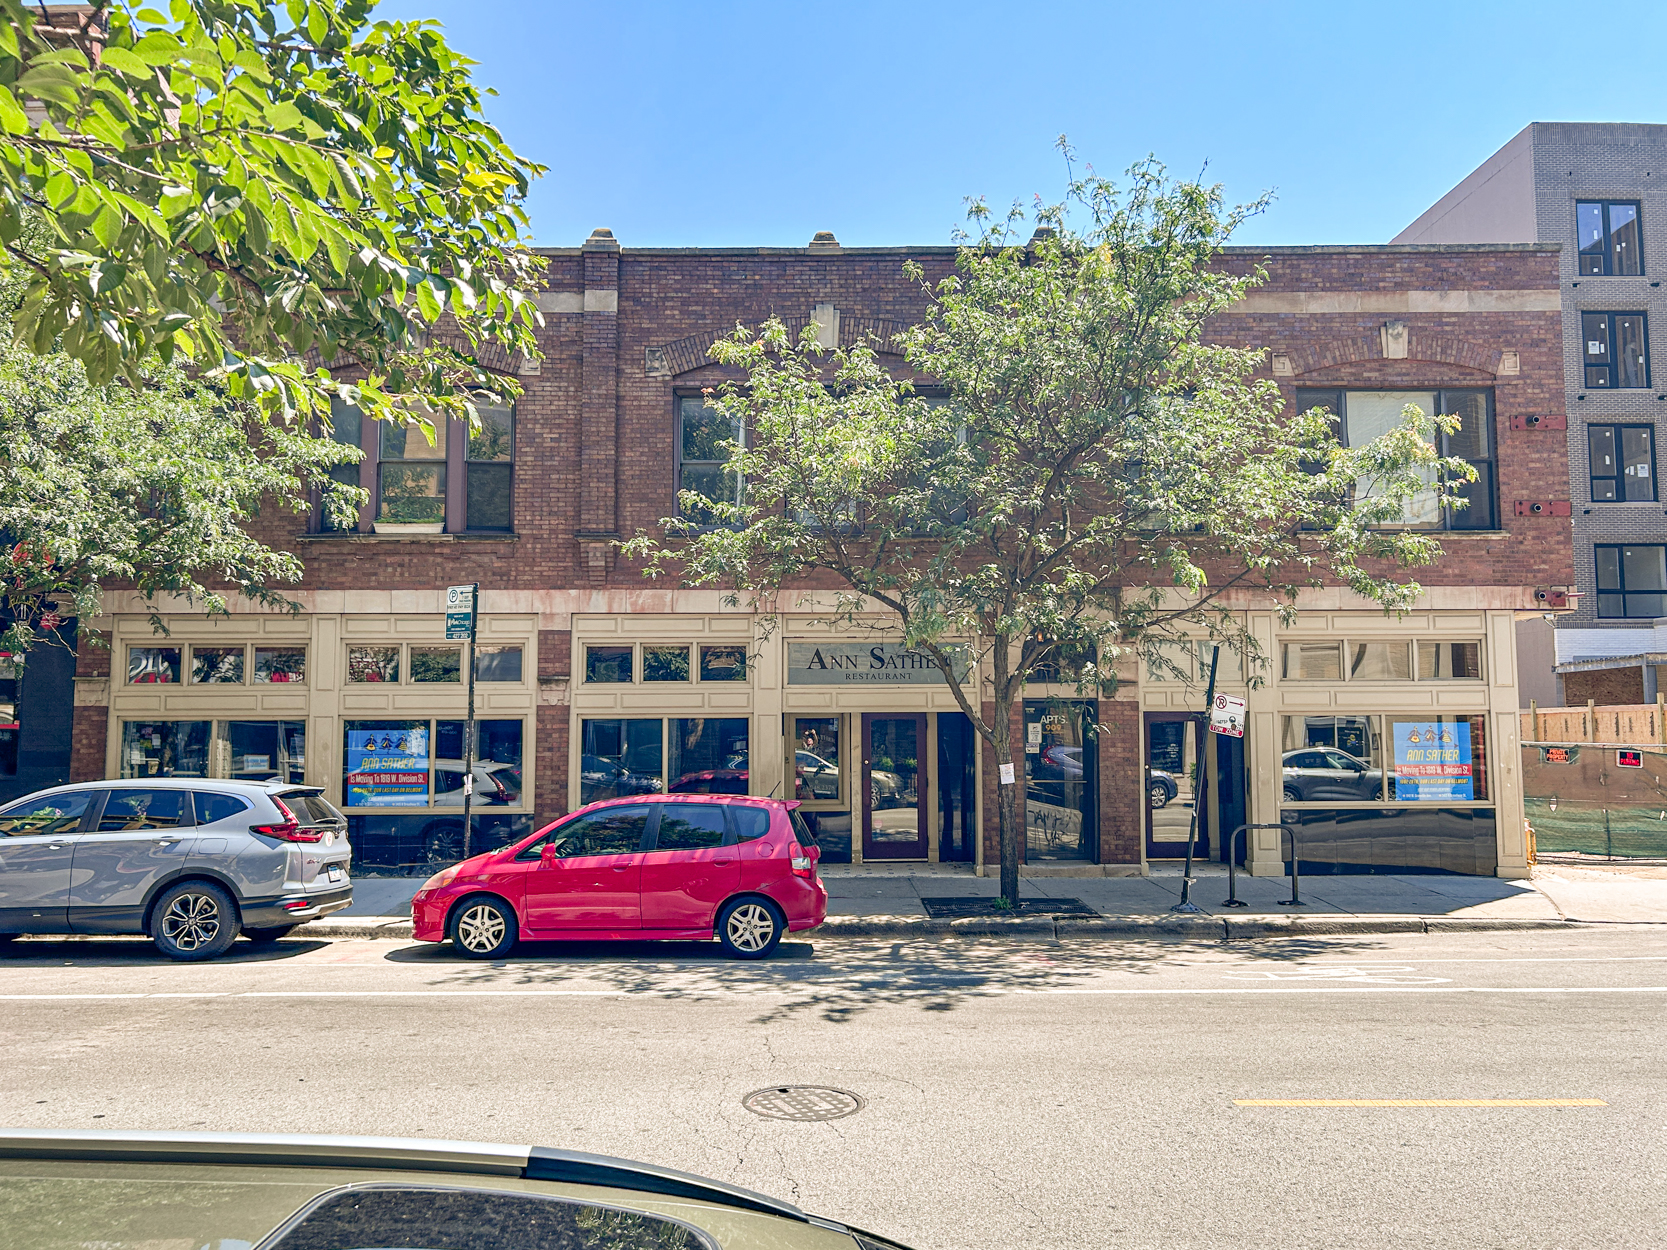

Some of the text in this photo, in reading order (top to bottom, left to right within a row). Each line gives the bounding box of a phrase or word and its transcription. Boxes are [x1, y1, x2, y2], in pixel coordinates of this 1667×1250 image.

[869, 647, 950, 670] SATHE
[1407, 749, 1460, 761] ANN SATHER
[361, 757, 415, 769] ANN SATHER
[1402, 766, 1419, 776] Moving
[1419, 765, 1426, 775] To
[1444, 765, 1463, 775] Division
[350, 774, 355, 783] Is
[356, 774, 373, 784] Moving
[374, 774, 380, 783] To
[391, 774, 398, 783] W.
[399, 773, 418, 783] Division
